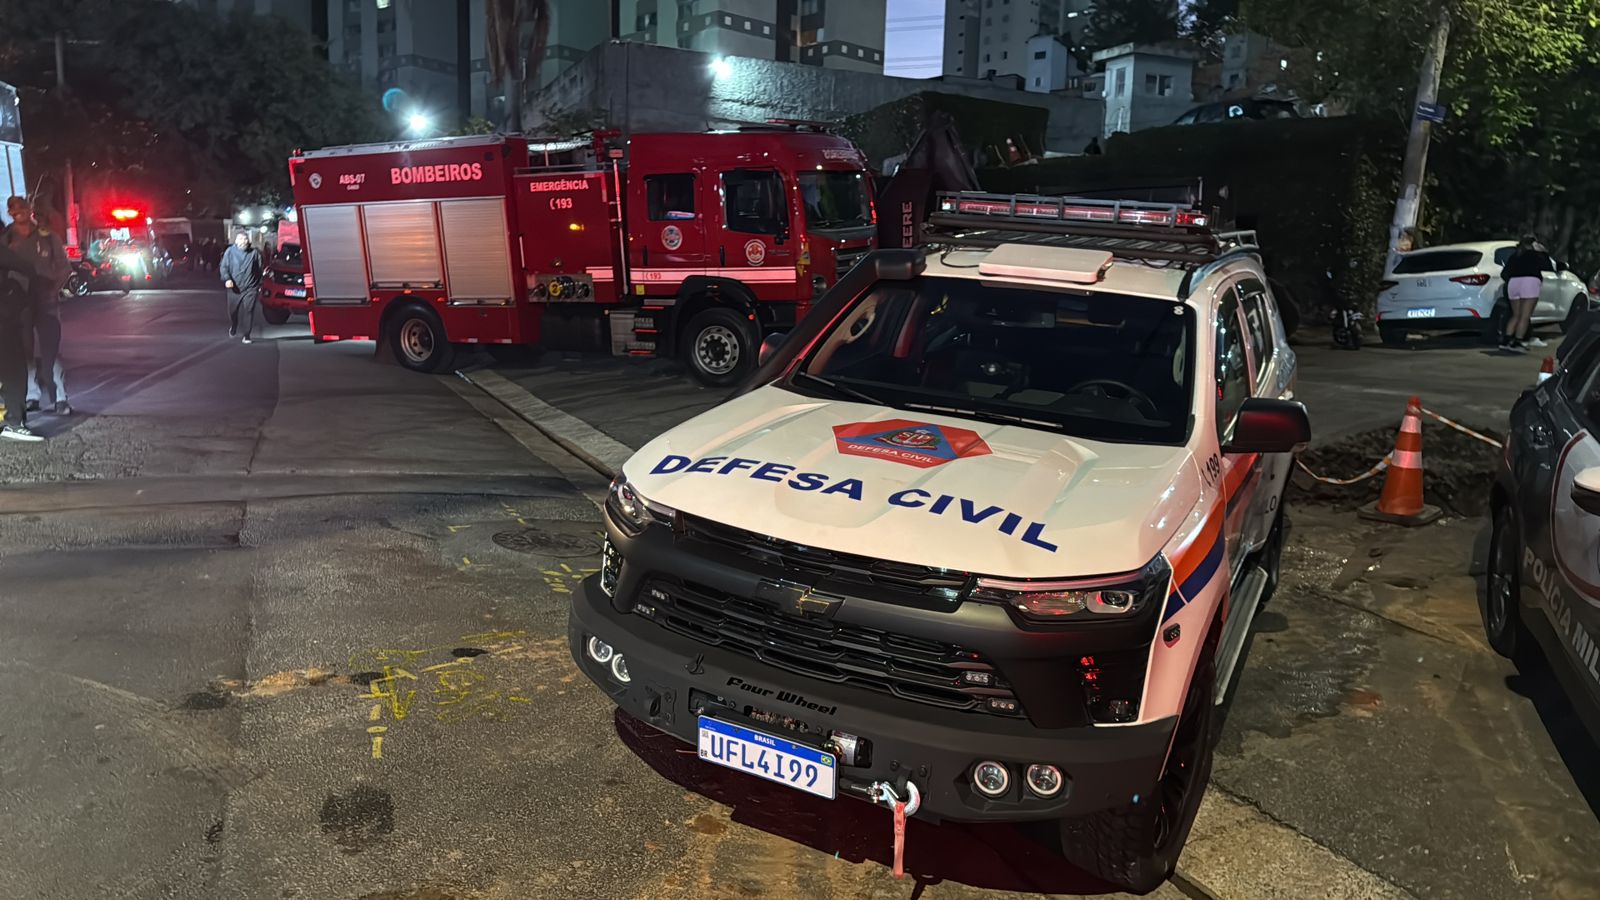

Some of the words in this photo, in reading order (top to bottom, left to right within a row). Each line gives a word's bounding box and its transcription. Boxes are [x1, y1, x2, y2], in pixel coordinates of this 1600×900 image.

[339, 174, 365, 184] ABS-07
[391, 163, 482, 184] BOMBEIROS
[530, 179, 589, 192] EMERGÊNCIA
[848, 444, 898, 456] DEFESA
[901, 451, 933, 463] CIVIL
[649, 454, 861, 500] DEFESA
[887, 488, 1058, 552] CIVIL
[726, 676, 774, 696] Four
[776, 690, 838, 716] Wheel
[754, 734, 776, 746] BRASIL
[700, 748, 708, 758] BR
[711, 734, 818, 788] UFL4I99
